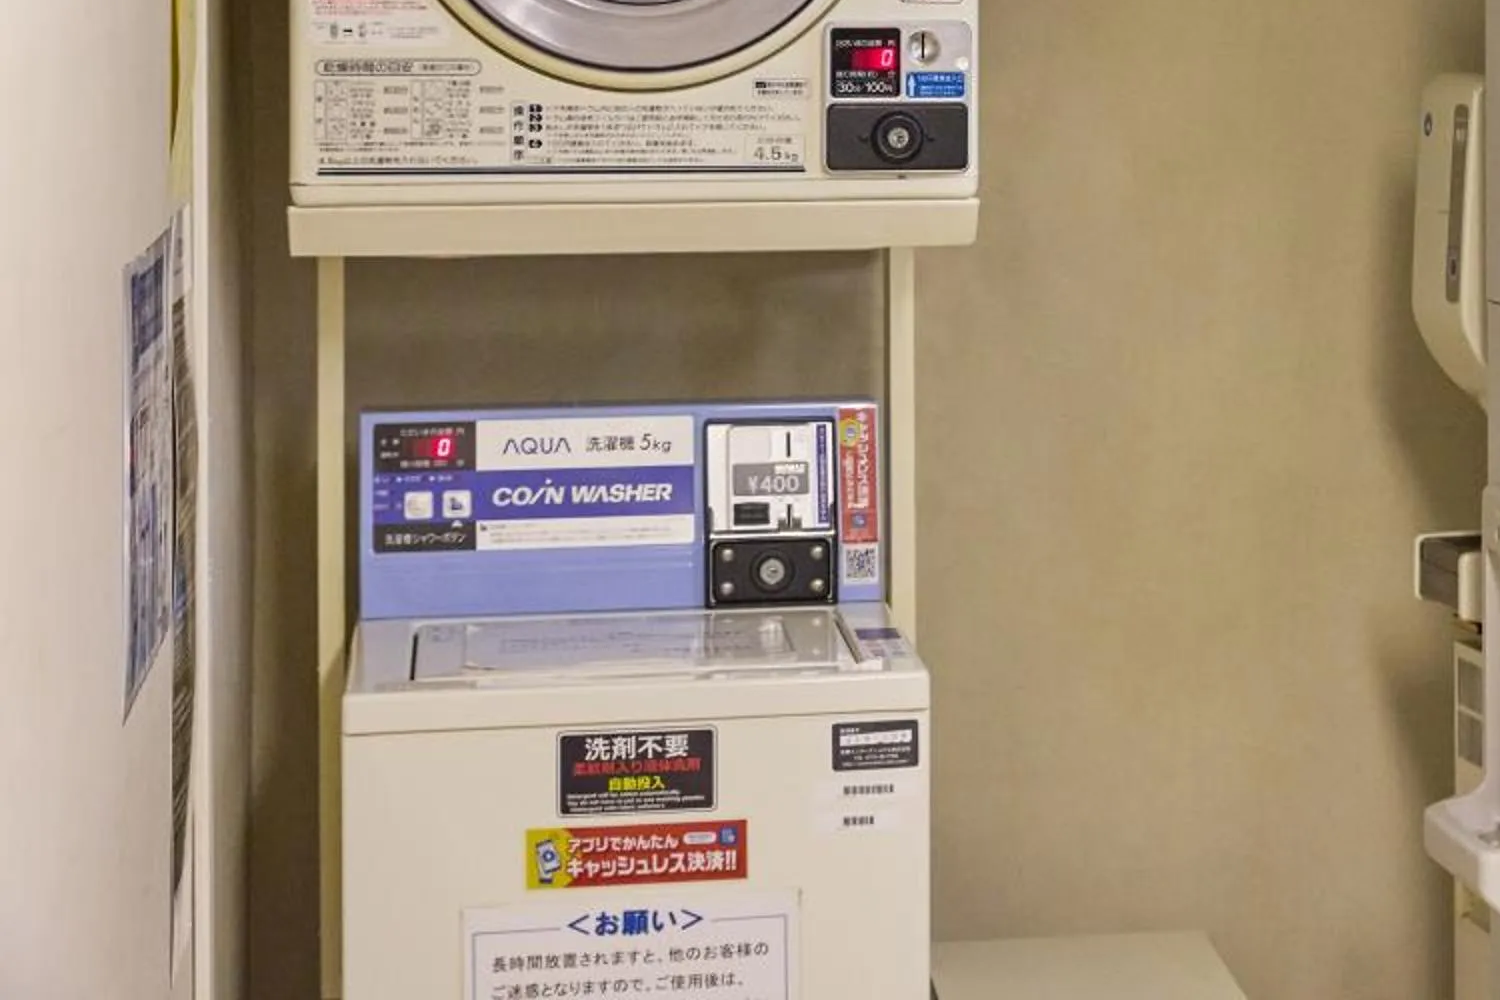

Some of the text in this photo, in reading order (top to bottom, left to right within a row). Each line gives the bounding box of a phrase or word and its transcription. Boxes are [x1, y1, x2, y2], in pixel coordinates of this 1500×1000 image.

[881, 49, 894, 67] 0
[436, 438, 450, 457] 0
[502, 433, 672, 455] AQUA 洗濯機 5kg
[492, 477, 673, 507] COIN WASHER
[749, 473, 801, 493] ¥400
[584, 733, 690, 762] 洗剤不要
[608, 775, 665, 792] 自動投入
[568, 833, 679, 853] アプリでかんたん
[567, 849, 738, 878] キャッシュレス決済!!
